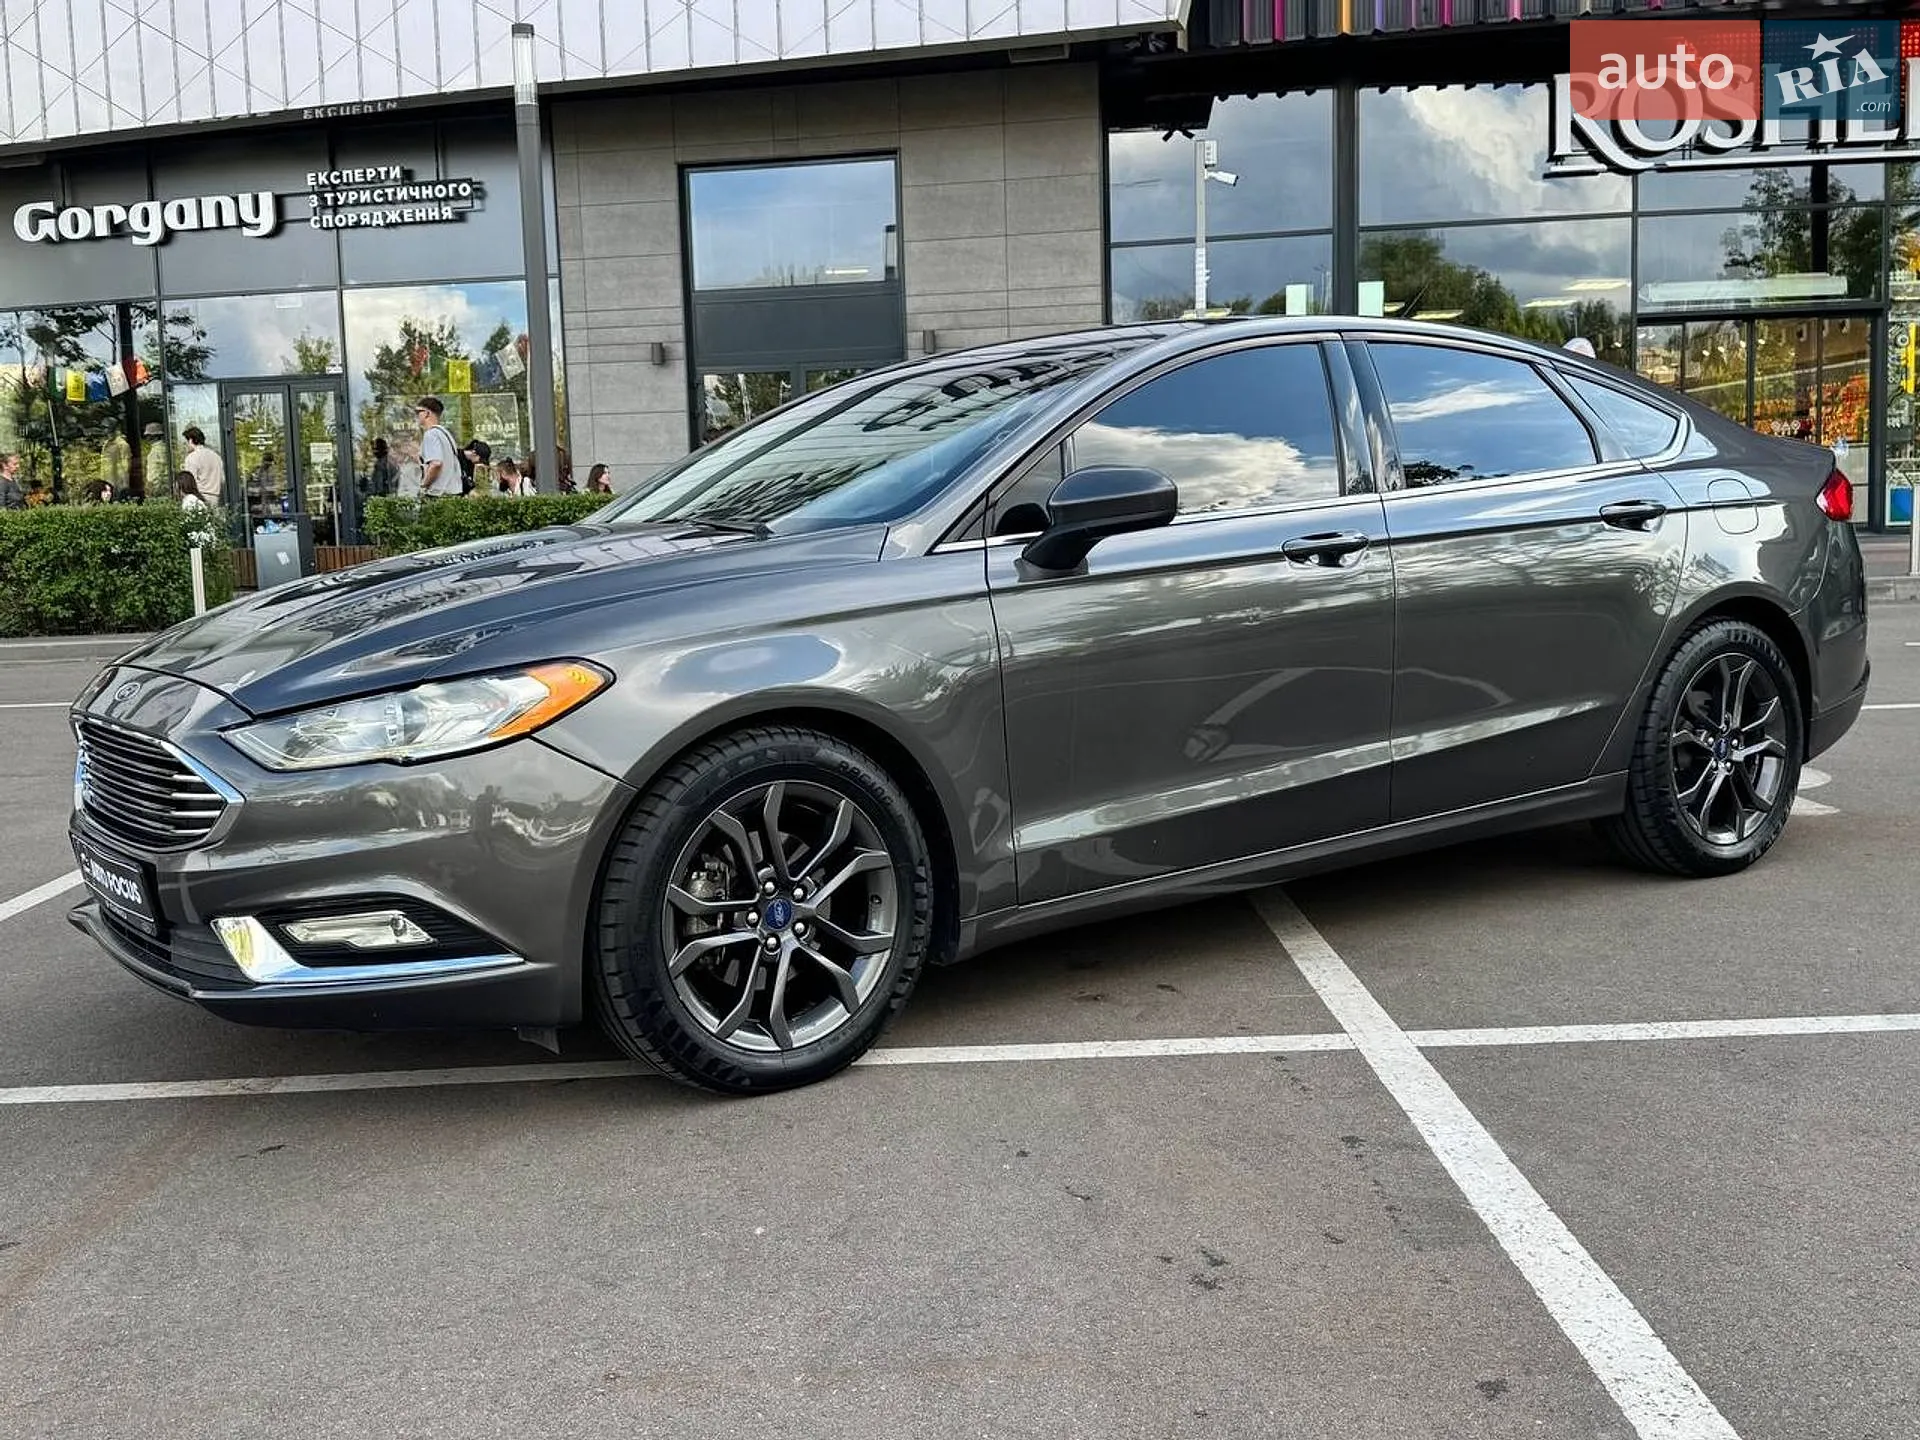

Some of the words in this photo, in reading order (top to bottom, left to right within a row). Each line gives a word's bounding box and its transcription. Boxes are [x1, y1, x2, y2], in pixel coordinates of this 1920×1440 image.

[1553, 57, 1920, 170] ROSHE
[307, 166, 401, 186] ЕКСПЕРТИ
[308, 194, 319, 208] З
[324, 182, 472, 206] ТУРИСТИЧНОГО
[13, 191, 277, 246] Gorgany
[310, 206, 453, 229] СПОРЯДЖЕННЯ
